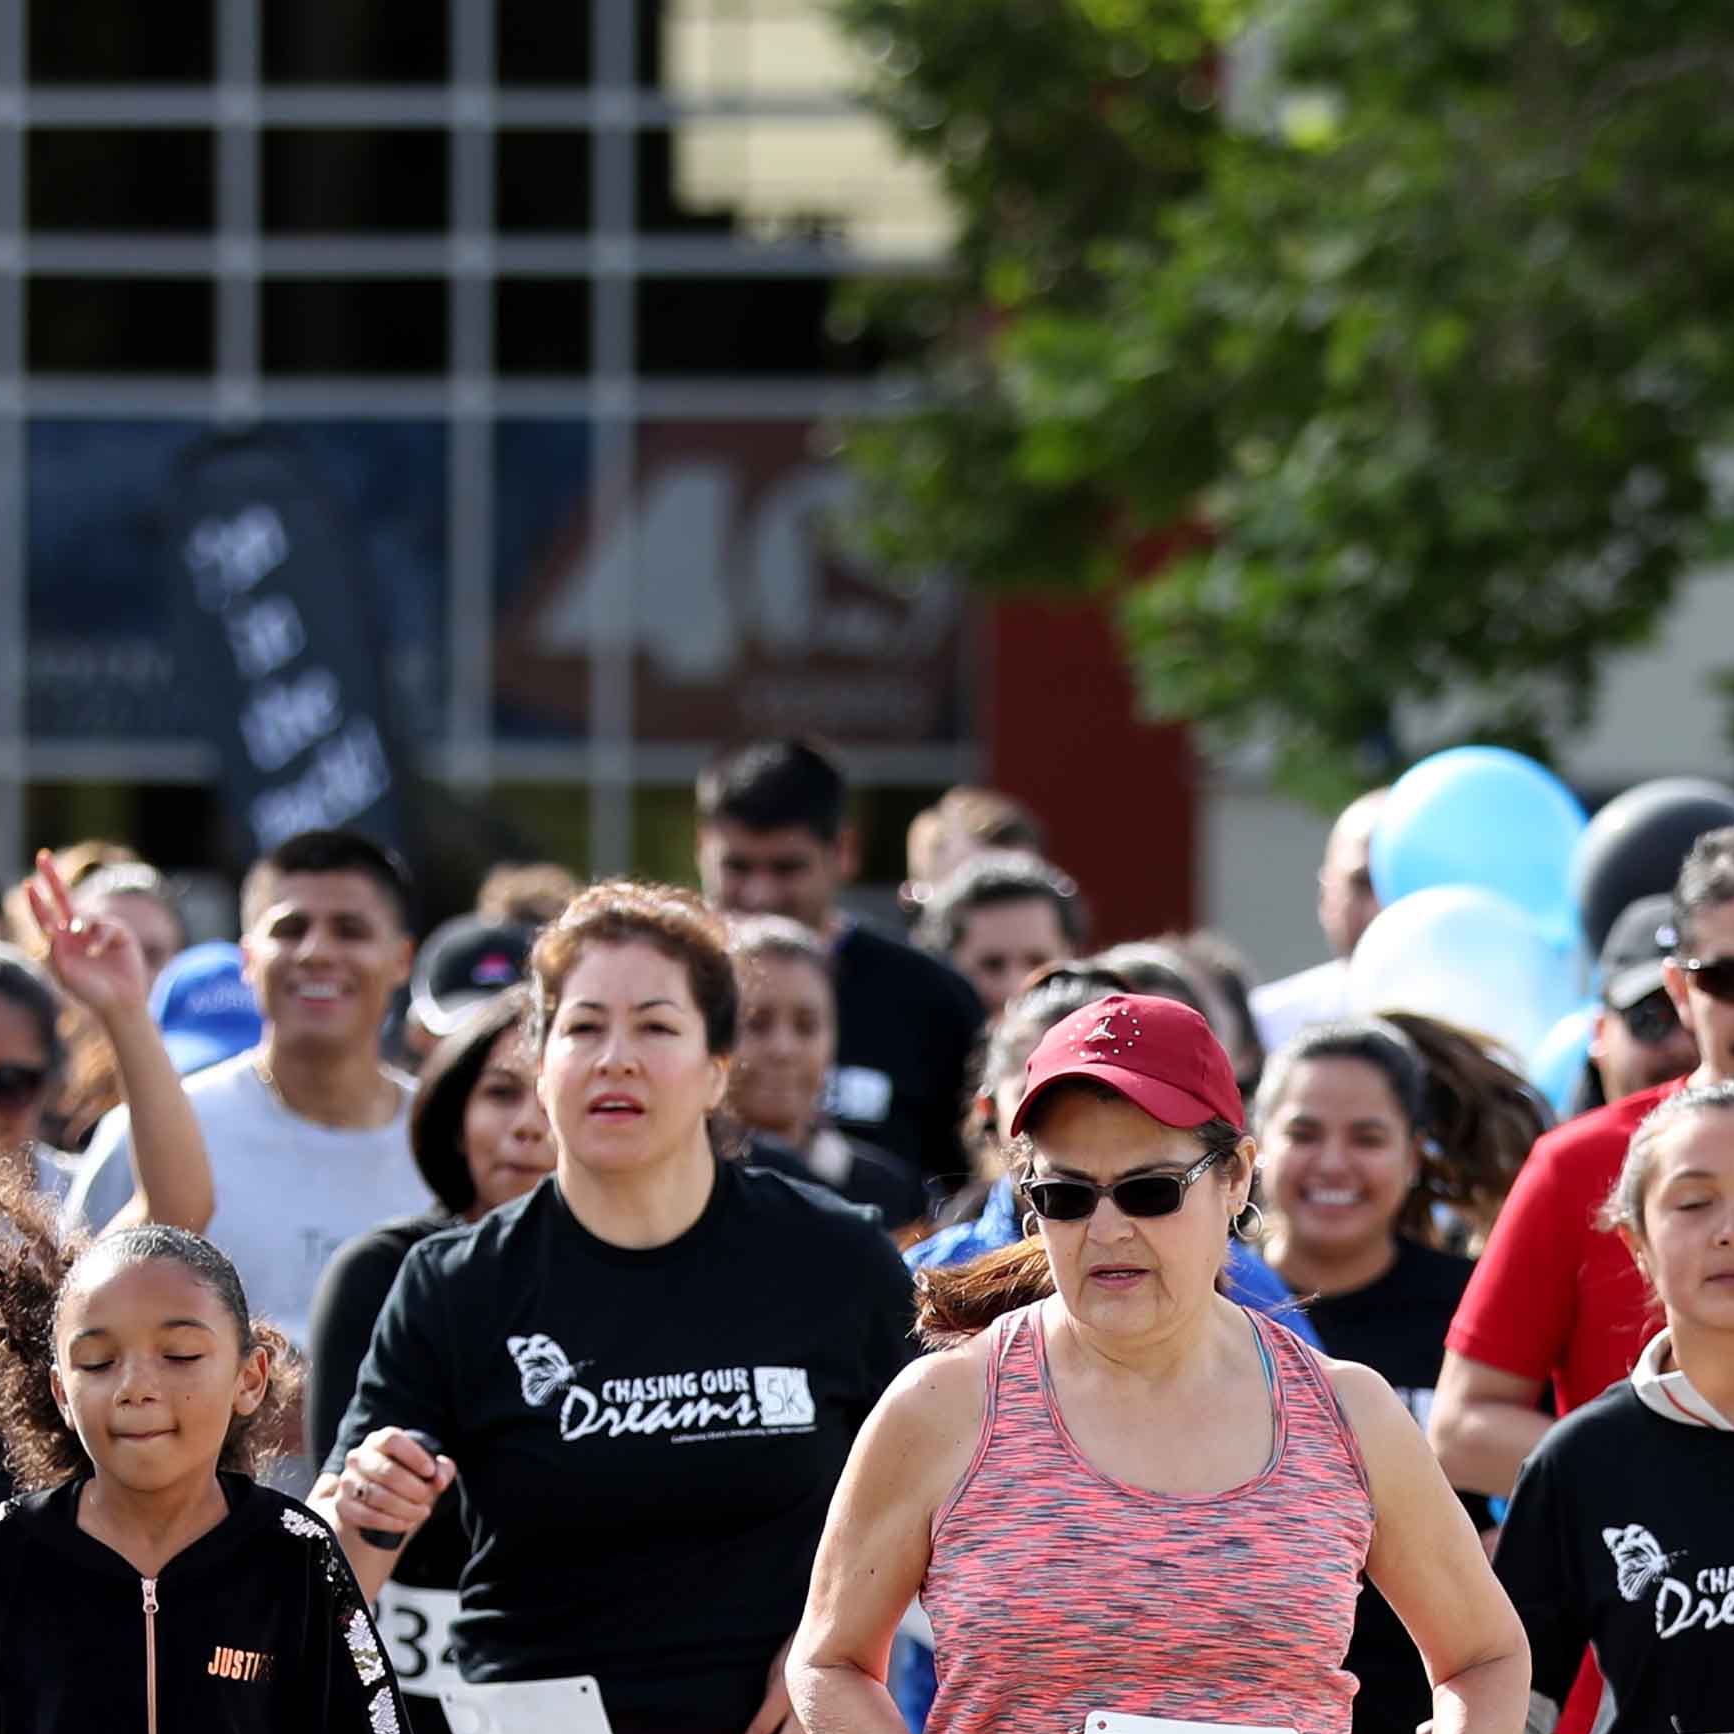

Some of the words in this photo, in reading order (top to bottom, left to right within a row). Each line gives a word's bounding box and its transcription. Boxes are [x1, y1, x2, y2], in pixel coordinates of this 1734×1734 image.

[602, 1372, 698, 1403] CHASING
[702, 1368, 750, 1394] OUR
[560, 1385, 757, 1440] Dreams
